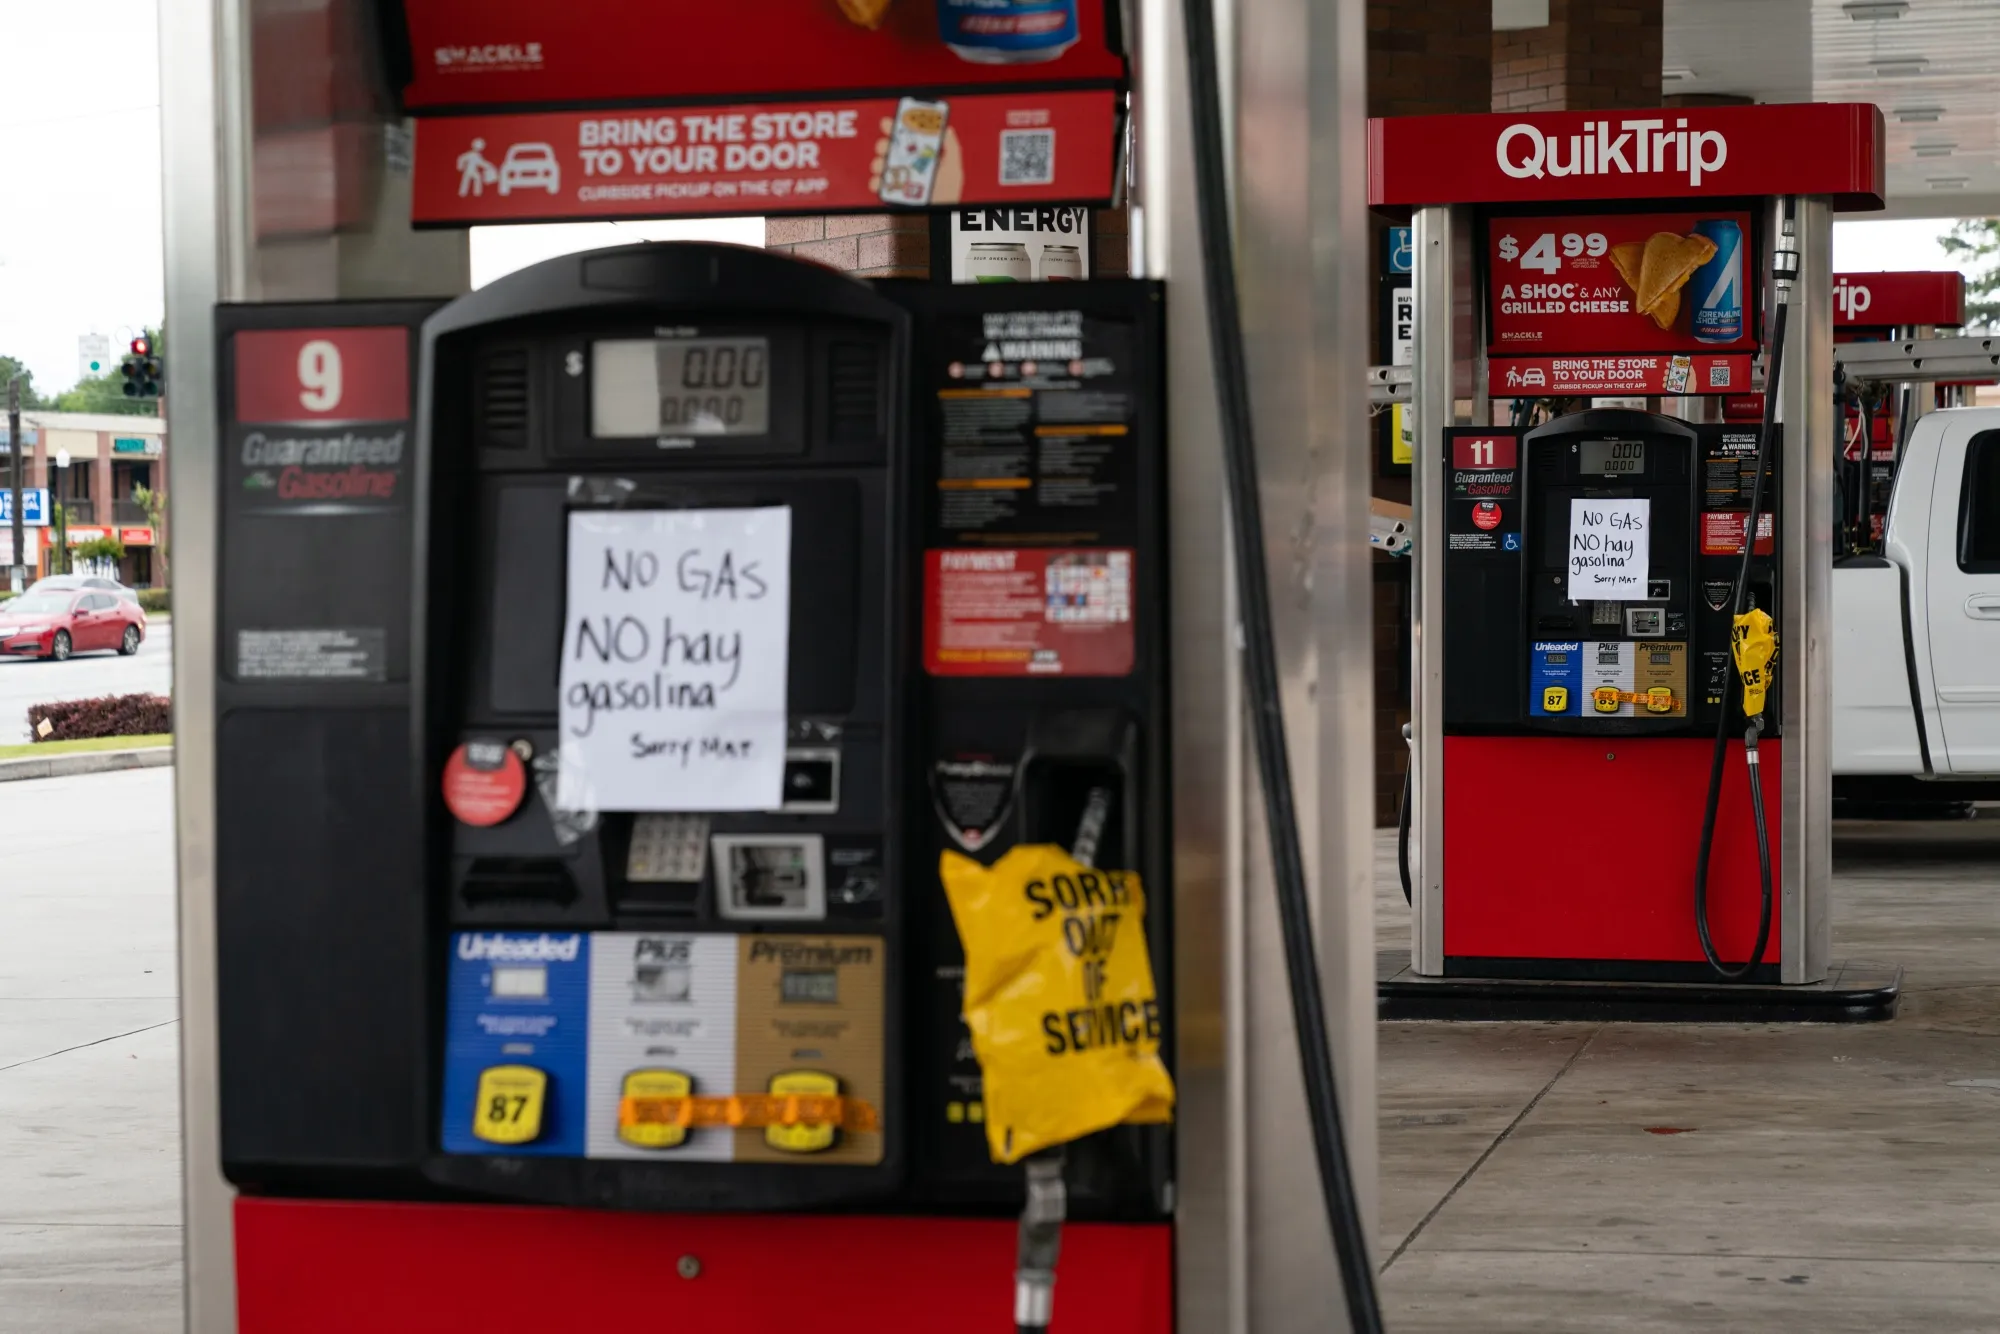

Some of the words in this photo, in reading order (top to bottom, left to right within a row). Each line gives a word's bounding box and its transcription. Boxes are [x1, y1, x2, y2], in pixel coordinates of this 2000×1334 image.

[578, 117, 677, 147] BRING
[682, 114, 746, 143] THE
[752, 110, 858, 141] STORE
[578, 149, 623, 175] TO
[629, 145, 718, 174] YOUR
[725, 141, 820, 169] DOOR
[1496, 117, 1728, 187] QuikTrip
[656, 182, 711, 199] PICKUP
[713, 181, 736, 197] ON
[738, 180, 768, 196] THE
[794, 178, 829, 194] APP
[959, 207, 1085, 235] ENERGY
[1501, 285, 1515, 299] A
[1580, 287, 1589, 298] &
[1593, 287, 1621, 298] ANY
[1501, 302, 1565, 315] GRILLED
[1569, 301, 1629, 314] CHEESE
[1698, 309, 1740, 318] ADRENALINE
[565, 351, 583, 376] $
[1553, 360, 1590, 370] BRING
[1592, 360, 1615, 370] THE
[1616, 359, 1657, 369] STORE
[1553, 371, 1571, 380] TO
[1572, 370, 1606, 380] YOUR
[1608, 370, 1643, 380] DOOR
[297, 340, 342, 412] 9
[242, 431, 405, 466] Guaranteed
[1470, 440, 1494, 465] 11
[1571, 445, 1577, 453] $
[1612, 443, 1642, 459] 0.00
[1604, 460, 1634, 471] 0.000
[278, 465, 396, 499] Gasoline
[1454, 472, 1514, 483] Guaranteed
[1468, 483, 1511, 495] Gasoline
[1582, 510, 1603, 526] NO
[1610, 512, 1642, 530] GAS
[1573, 533, 1600, 550] NO
[1604, 534, 1634, 560] hay
[602, 547, 658, 592] NO
[676, 549, 768, 600] GAS
[1571, 553, 1625, 575] gasolina
[1594, 574, 1616, 586] Sorry
[575, 616, 649, 663] NO
[661, 616, 742, 691] hay
[1535, 642, 1578, 651] Unleaded
[1598, 642, 1618, 651] Plus
[1639, 642, 1683, 651] Premium
[1741, 669, 1760, 686] CE
[567, 672, 716, 738] gasolina
[1548, 696, 1562, 705] 87
[630, 732, 692, 768] Sorry
[1025, 869, 1130, 921] SORR
[457, 932, 581, 963] Unleaded
[634, 938, 693, 962] Plus
[748, 940, 873, 965] Premium
[487, 1096, 527, 1126] 87
